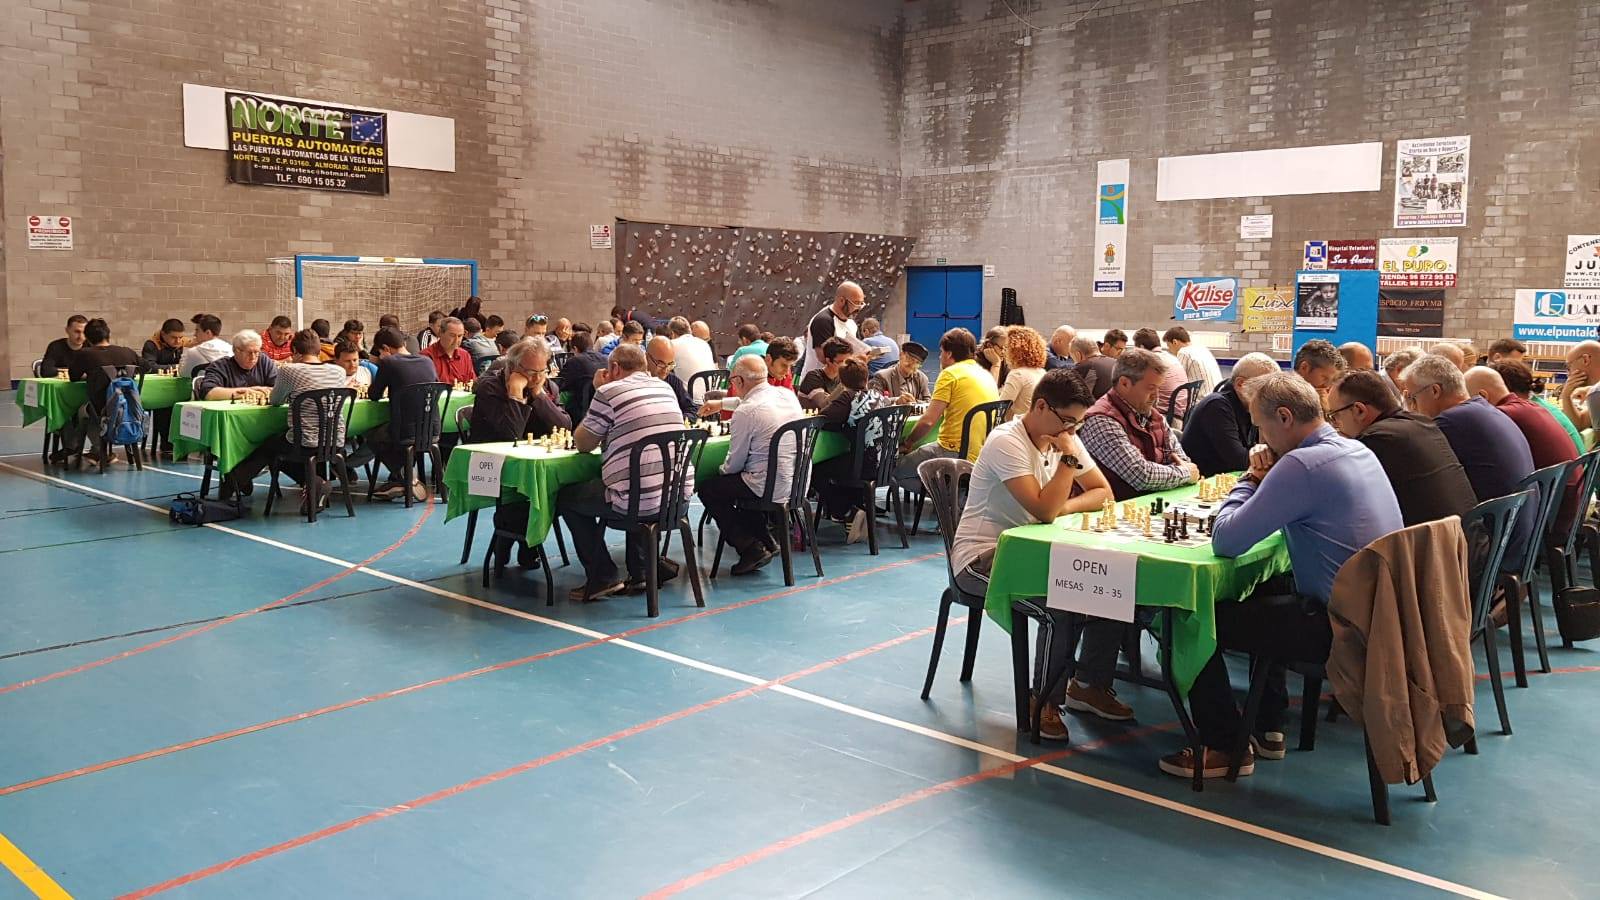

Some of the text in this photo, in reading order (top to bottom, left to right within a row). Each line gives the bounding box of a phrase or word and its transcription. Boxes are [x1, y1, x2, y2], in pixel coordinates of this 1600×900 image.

[230, 96, 345, 139] NORTE
[232, 131, 384, 156] PUERTAS AUTOMATICAS
[233, 143, 384, 165] LAS PUERTAS AUTOMATICAS DE LA VEGA BAJA
[353, 165, 384, 173] ALICANTE
[275, 173, 346, 188] TLF. 690 15 05 32
[1330, 254, 1347, 264] San
[1383, 260, 1399, 272] EL
[1403, 259, 1447, 272] PURO
[1575, 260, 1600, 270] JU
[1181, 281, 1234, 310] Kalise
[1072, 558, 1108, 576] OPEN
[1055, 578, 1084, 592] MESAS
[1092, 585, 1104, 595] 28
[1111, 588, 1122, 599] 35
